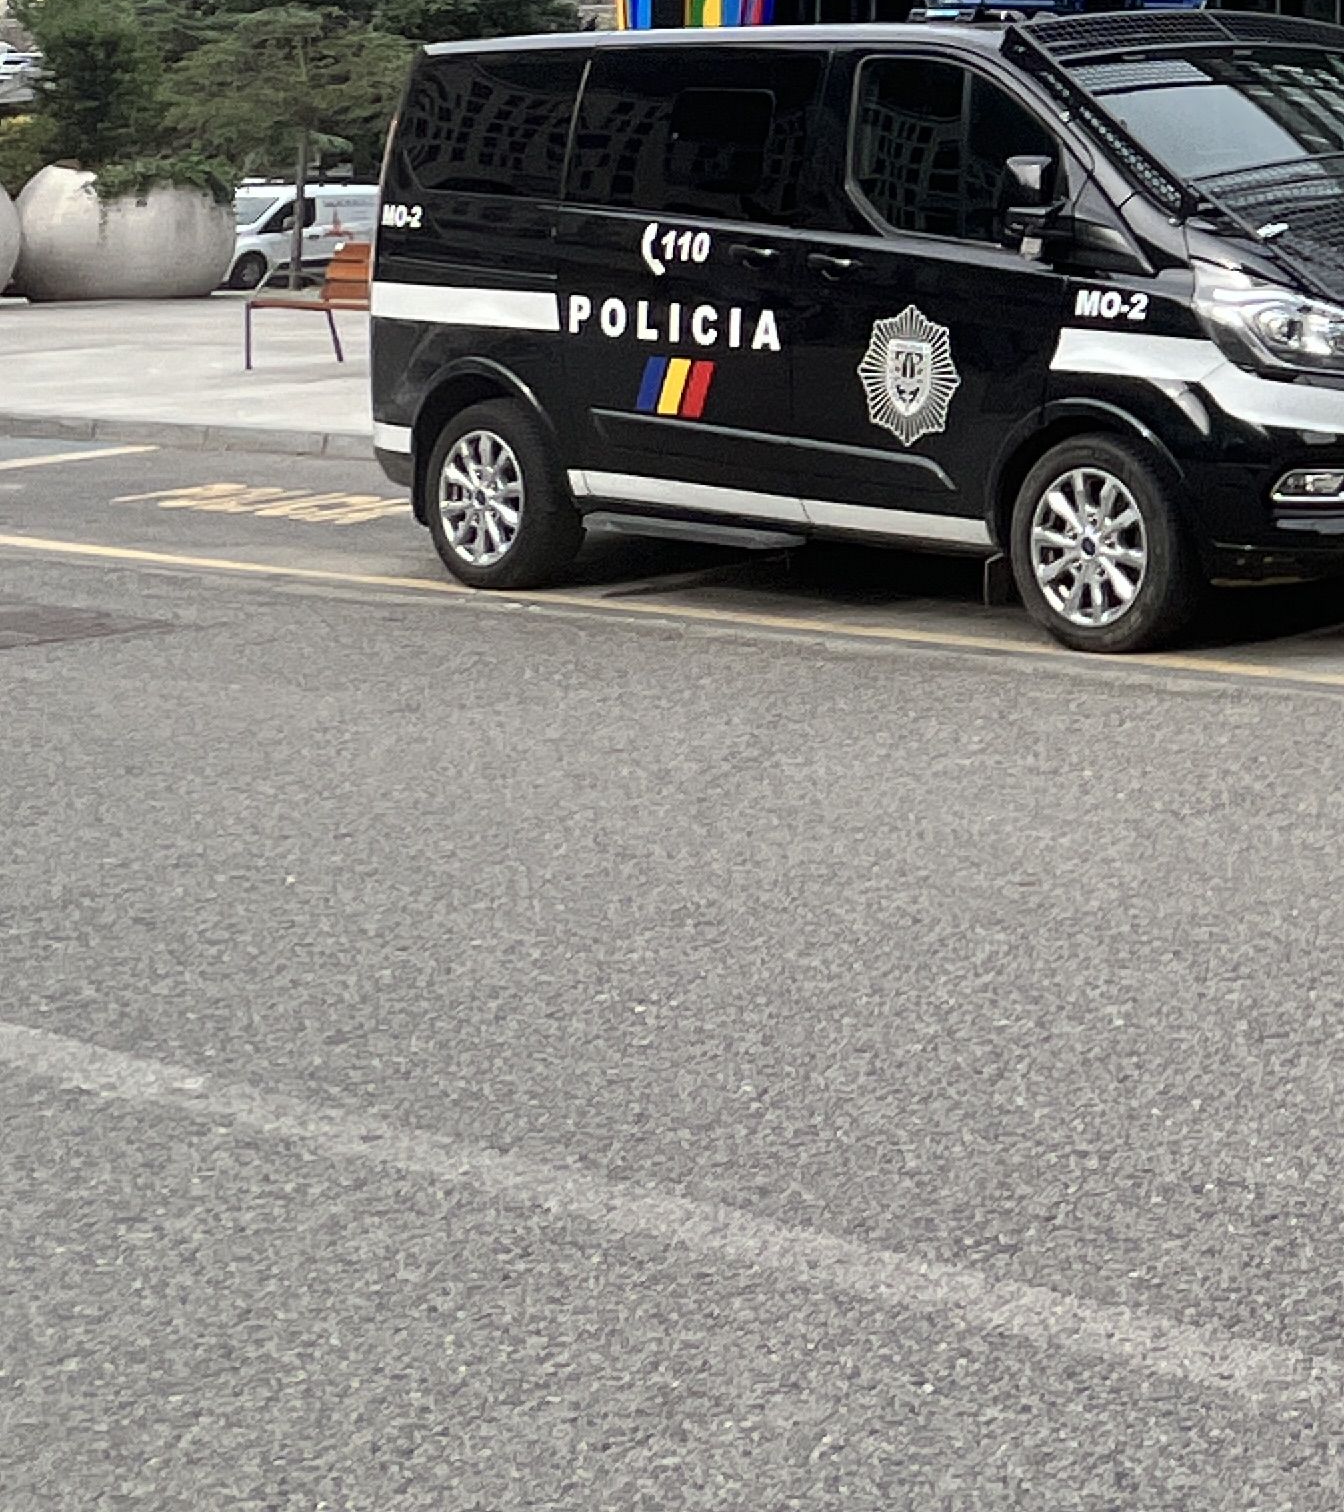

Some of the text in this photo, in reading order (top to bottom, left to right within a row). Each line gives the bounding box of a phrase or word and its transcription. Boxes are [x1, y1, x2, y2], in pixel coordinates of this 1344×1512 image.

[382, 204, 423, 228] MO-2
[661, 230, 711, 263] 110
[1074, 289, 1150, 320] MO-2
[568, 294, 782, 352] POLICIA
